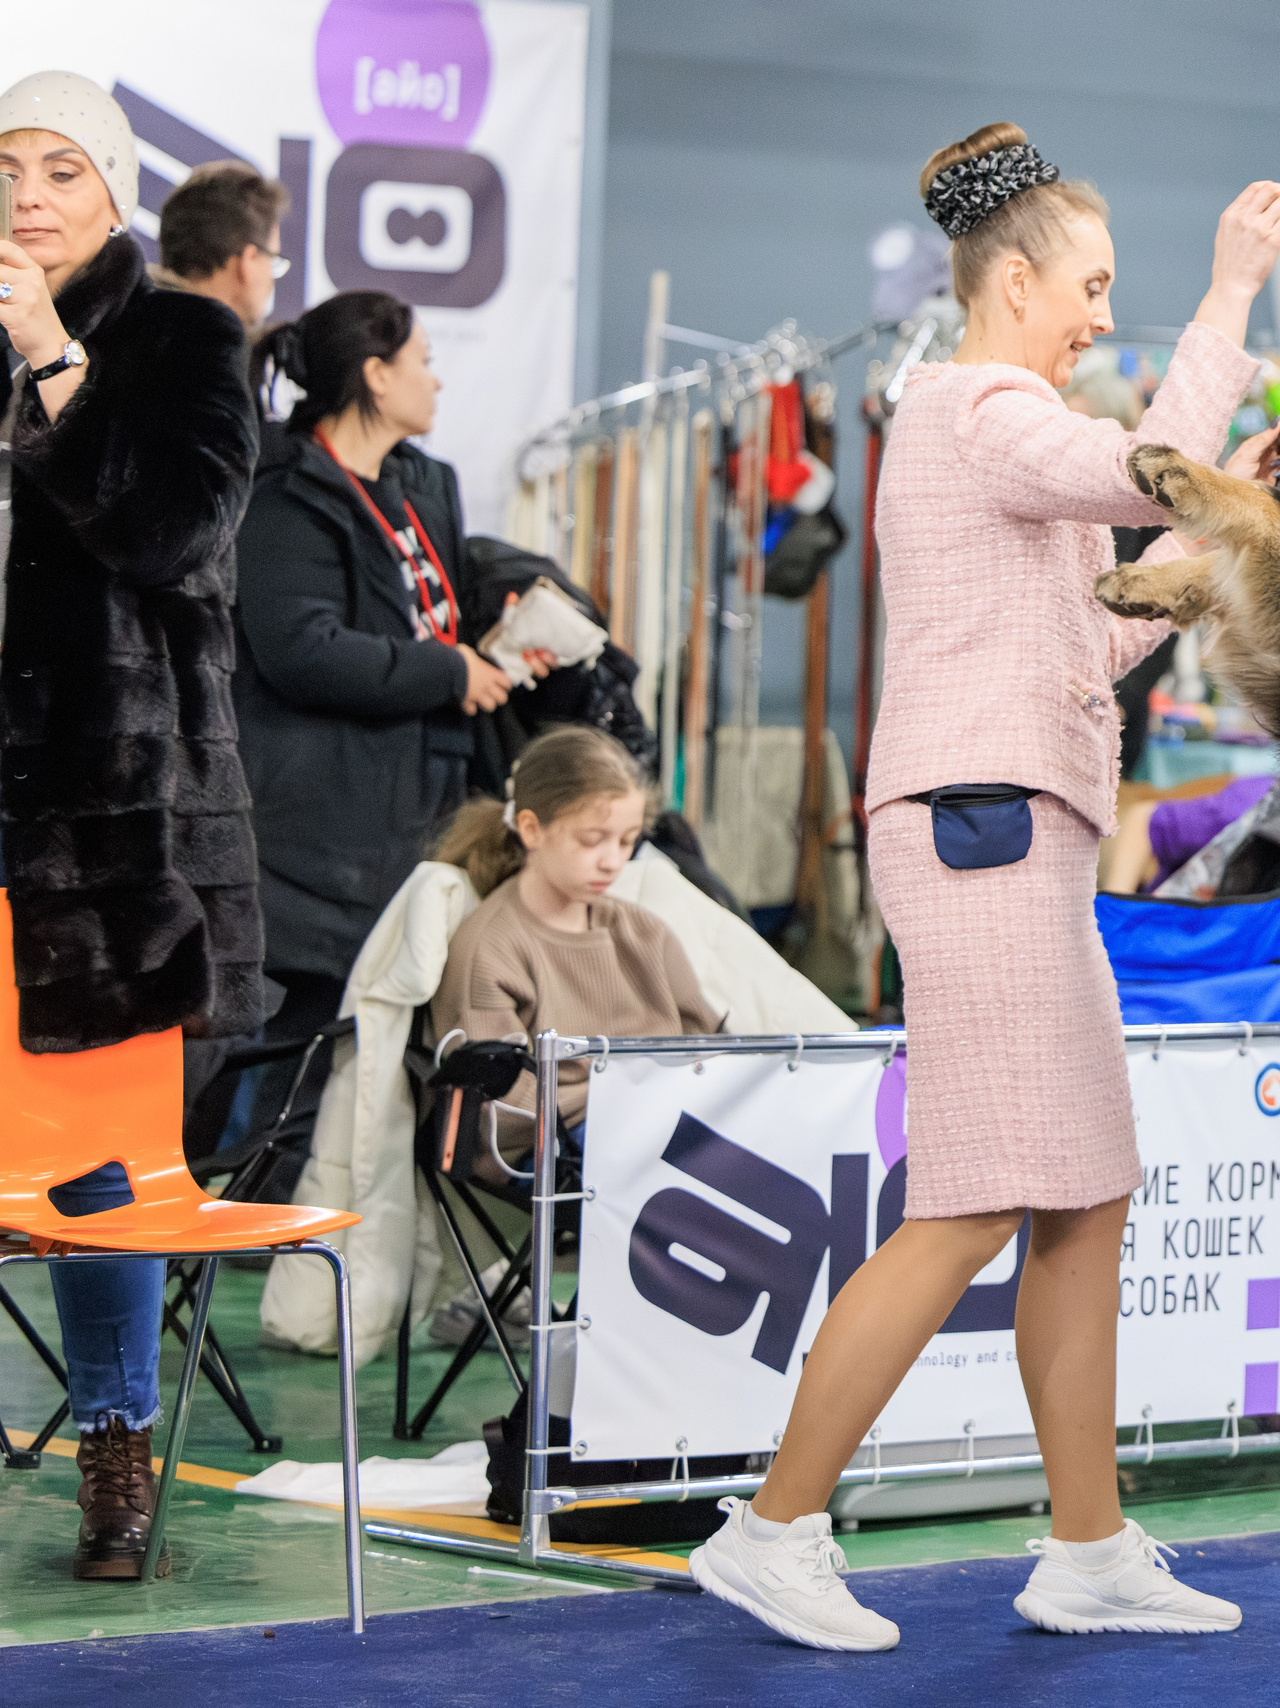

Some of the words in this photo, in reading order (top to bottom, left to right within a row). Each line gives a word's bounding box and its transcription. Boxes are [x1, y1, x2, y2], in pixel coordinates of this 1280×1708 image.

[1131, 1164, 1180, 1206] ИЕ
[1163, 1214, 1265, 1260] КОШЕК
[1120, 1271, 1221, 1318] СОБАК
[913, 1351, 969, 1368] hnology
[976, 1350, 999, 1364] and
